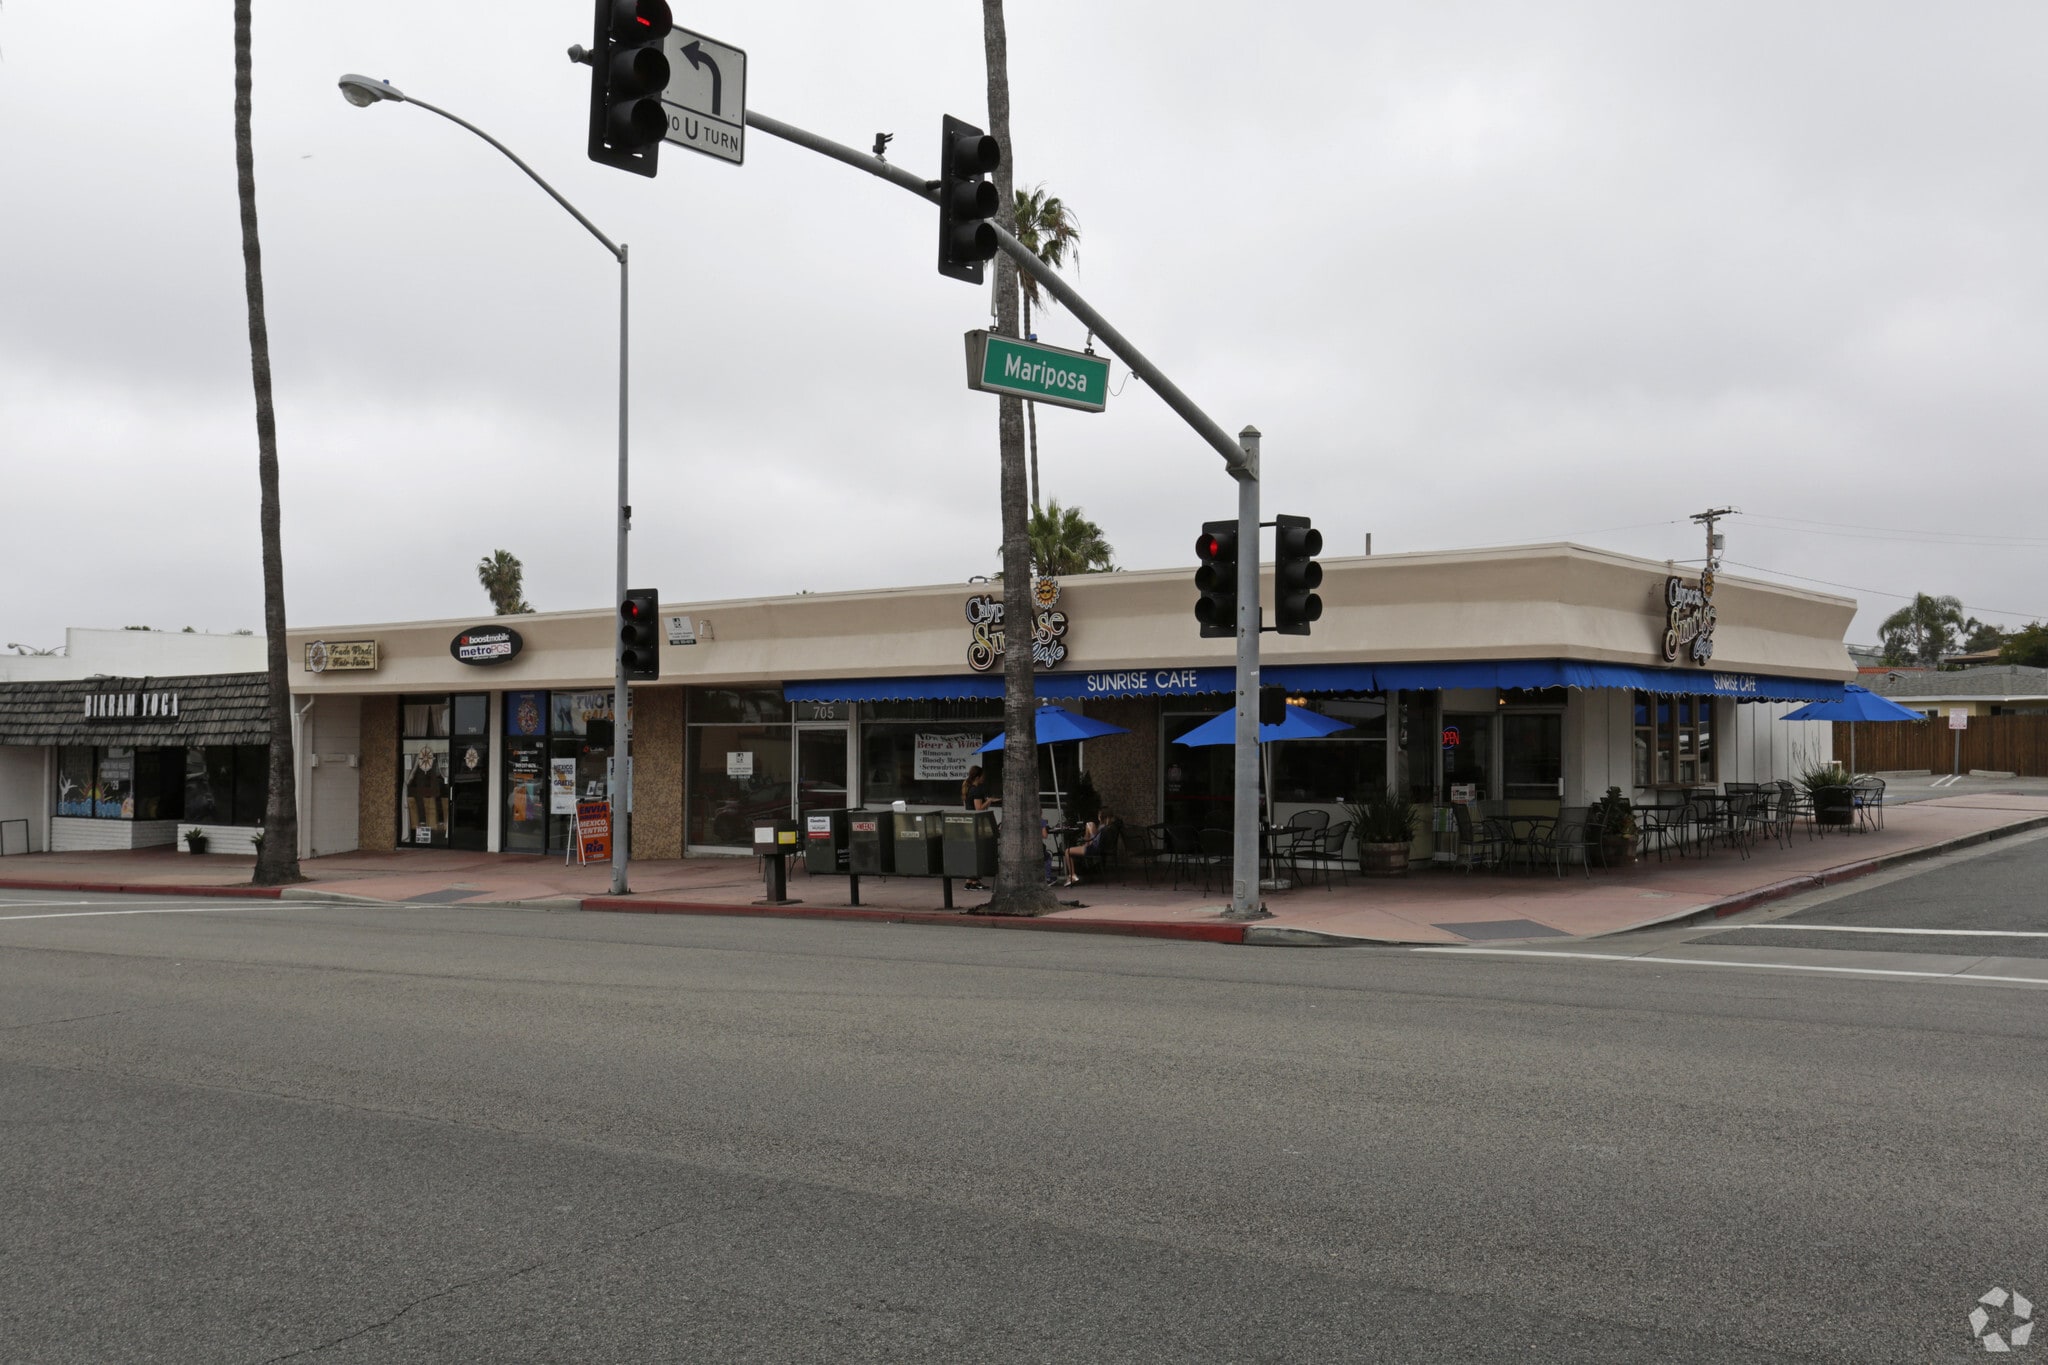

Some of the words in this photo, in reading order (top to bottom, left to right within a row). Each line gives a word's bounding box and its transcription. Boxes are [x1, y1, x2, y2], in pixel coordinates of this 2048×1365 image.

[667, 114, 680, 131] O
[685, 117, 698, 140] U
[704, 127, 738, 151] TURN
[1005, 353, 1087, 392] Mariposa
[967, 597, 1005, 624] Calyp
[460, 644, 510, 656] metroPCS
[968, 612, 1065, 671] Suse
[1087, 672, 1148, 691] SUNRISE
[1155, 670, 1198, 688] CAFE
[1713, 674, 1738, 691] SUNRISE
[1740, 676, 1756, 691] CAFE
[85, 694, 135, 717] BIKRAM
[143, 693, 178, 716] YOGA
[576, 695, 604, 710] TWO
[813, 706, 834, 719] 705
[922, 757, 944, 765] Bloody
[580, 805, 607, 814] ENVIA
[580, 827, 608, 835] CENTRO
